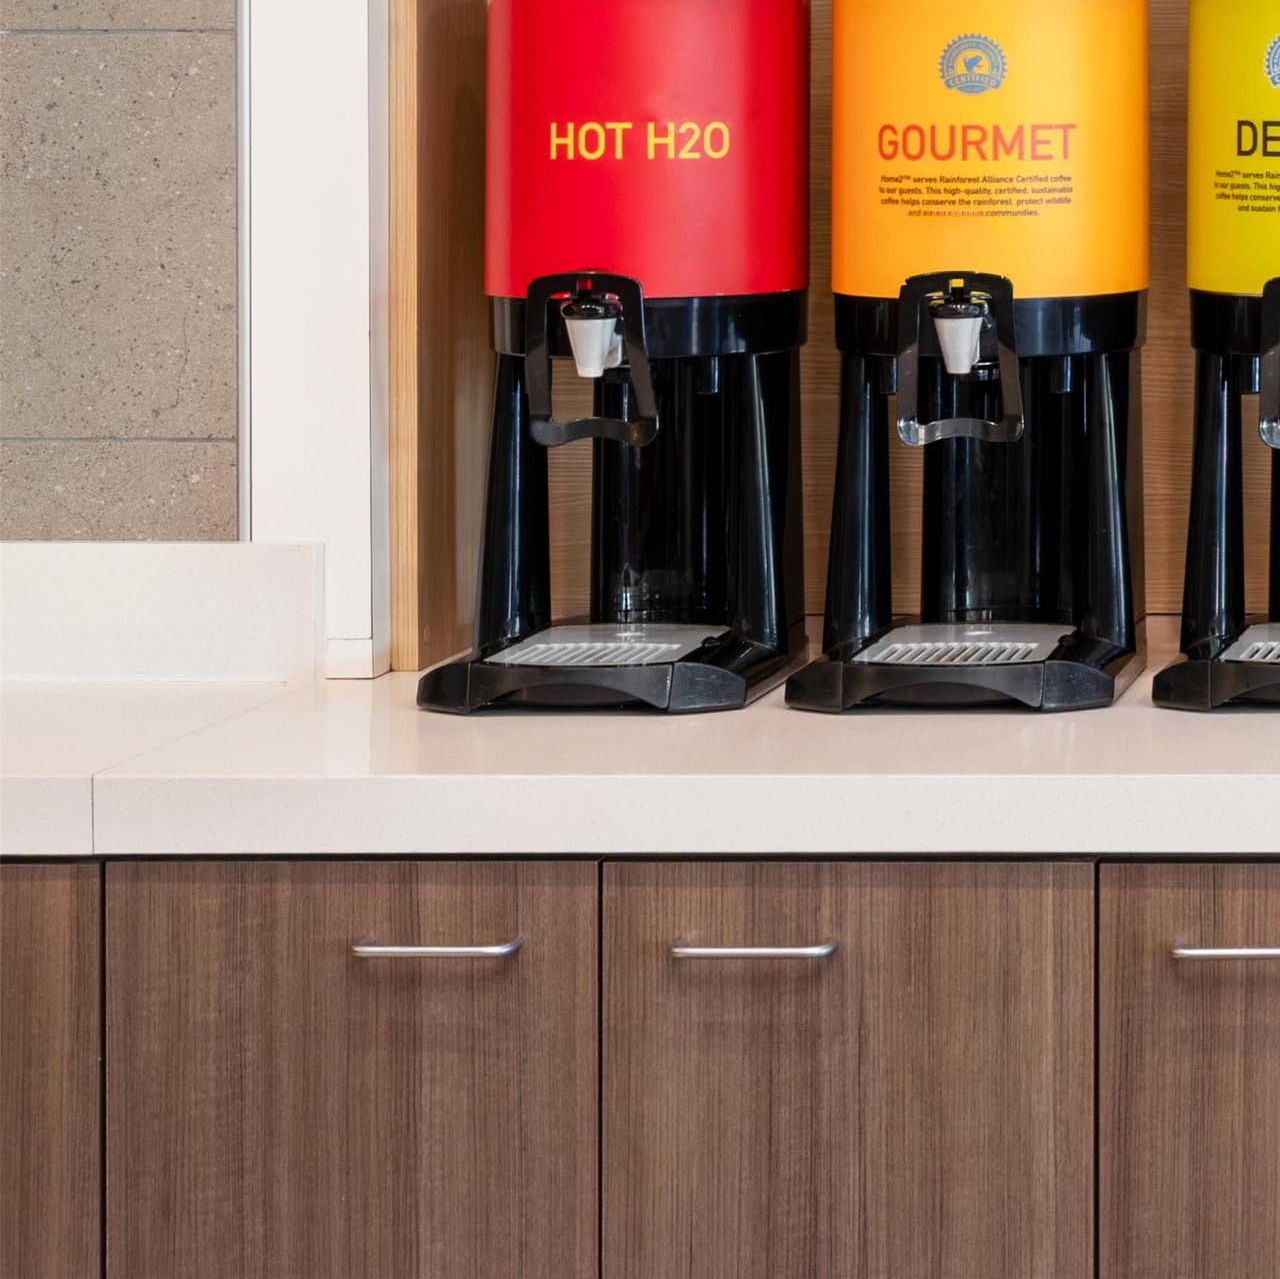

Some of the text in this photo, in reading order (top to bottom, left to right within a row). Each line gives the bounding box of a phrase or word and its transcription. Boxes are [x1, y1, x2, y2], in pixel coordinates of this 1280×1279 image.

[550, 122, 632, 160] HOT
[878, 123, 1077, 161] GOURMET
[939, 175, 980, 183] Rainforest
[981, 175, 1014, 183] Alliance
[1016, 175, 1048, 183] Certified
[1050, 174, 1072, 182] coffee
[1242, 171, 1264, 179] serves
[926, 186, 941, 194] This
[1031, 186, 1073, 194] sustainable
[1253, 182, 1268, 190] This
[1232, 192, 1248, 201] helps
[880, 197, 899, 205] coffee
[901, 198, 920, 206] helps
[1016, 198, 1043, 207] protect
[1045, 197, 1071, 205] wildlife
